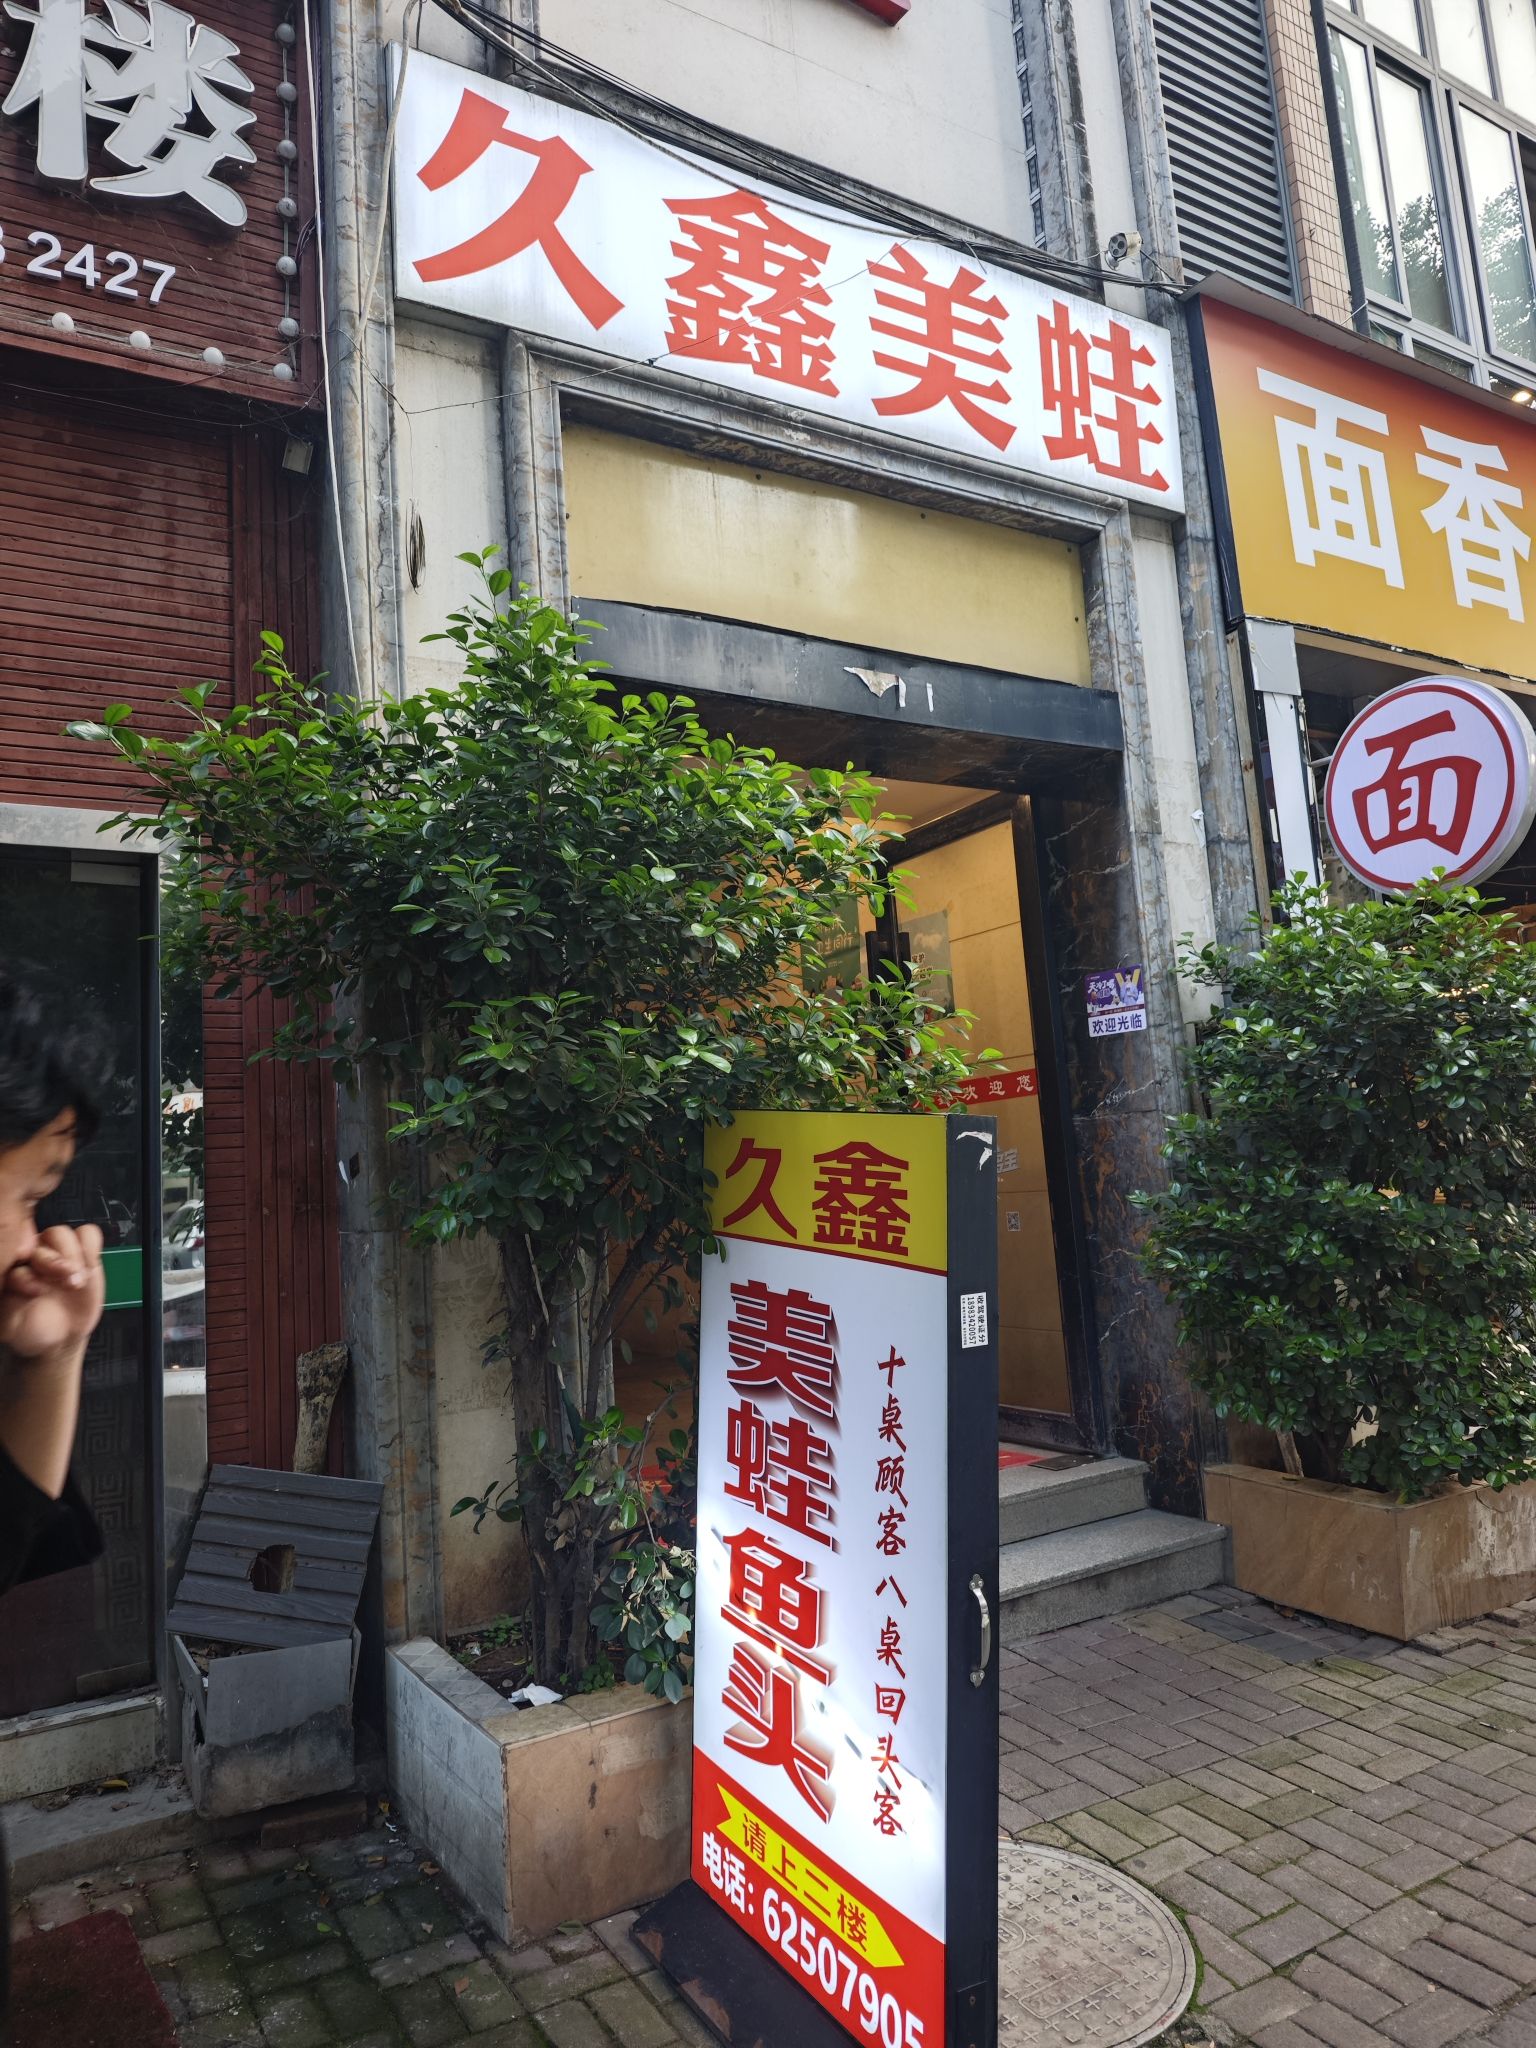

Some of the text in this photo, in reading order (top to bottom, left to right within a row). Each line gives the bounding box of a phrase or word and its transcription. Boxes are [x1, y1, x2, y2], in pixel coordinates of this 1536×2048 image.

[2, 0, 257, 226] 楼
[27, 231, 176, 305] 2427
[412, 88, 1170, 492] 久鑫美蛙
[1256, 366, 1532, 623] 面香
[1352, 709, 1482, 855] 面
[1092, 1013, 1142, 1034] 欢迎光临
[723, 1138, 911, 1257] 久鑫
[720, 1279, 838, 1825] 美蛙鱼头
[871, 1344, 909, 1836] 十桌顾客八桌回头客
[742, 1812, 868, 1953] 请上二楼
